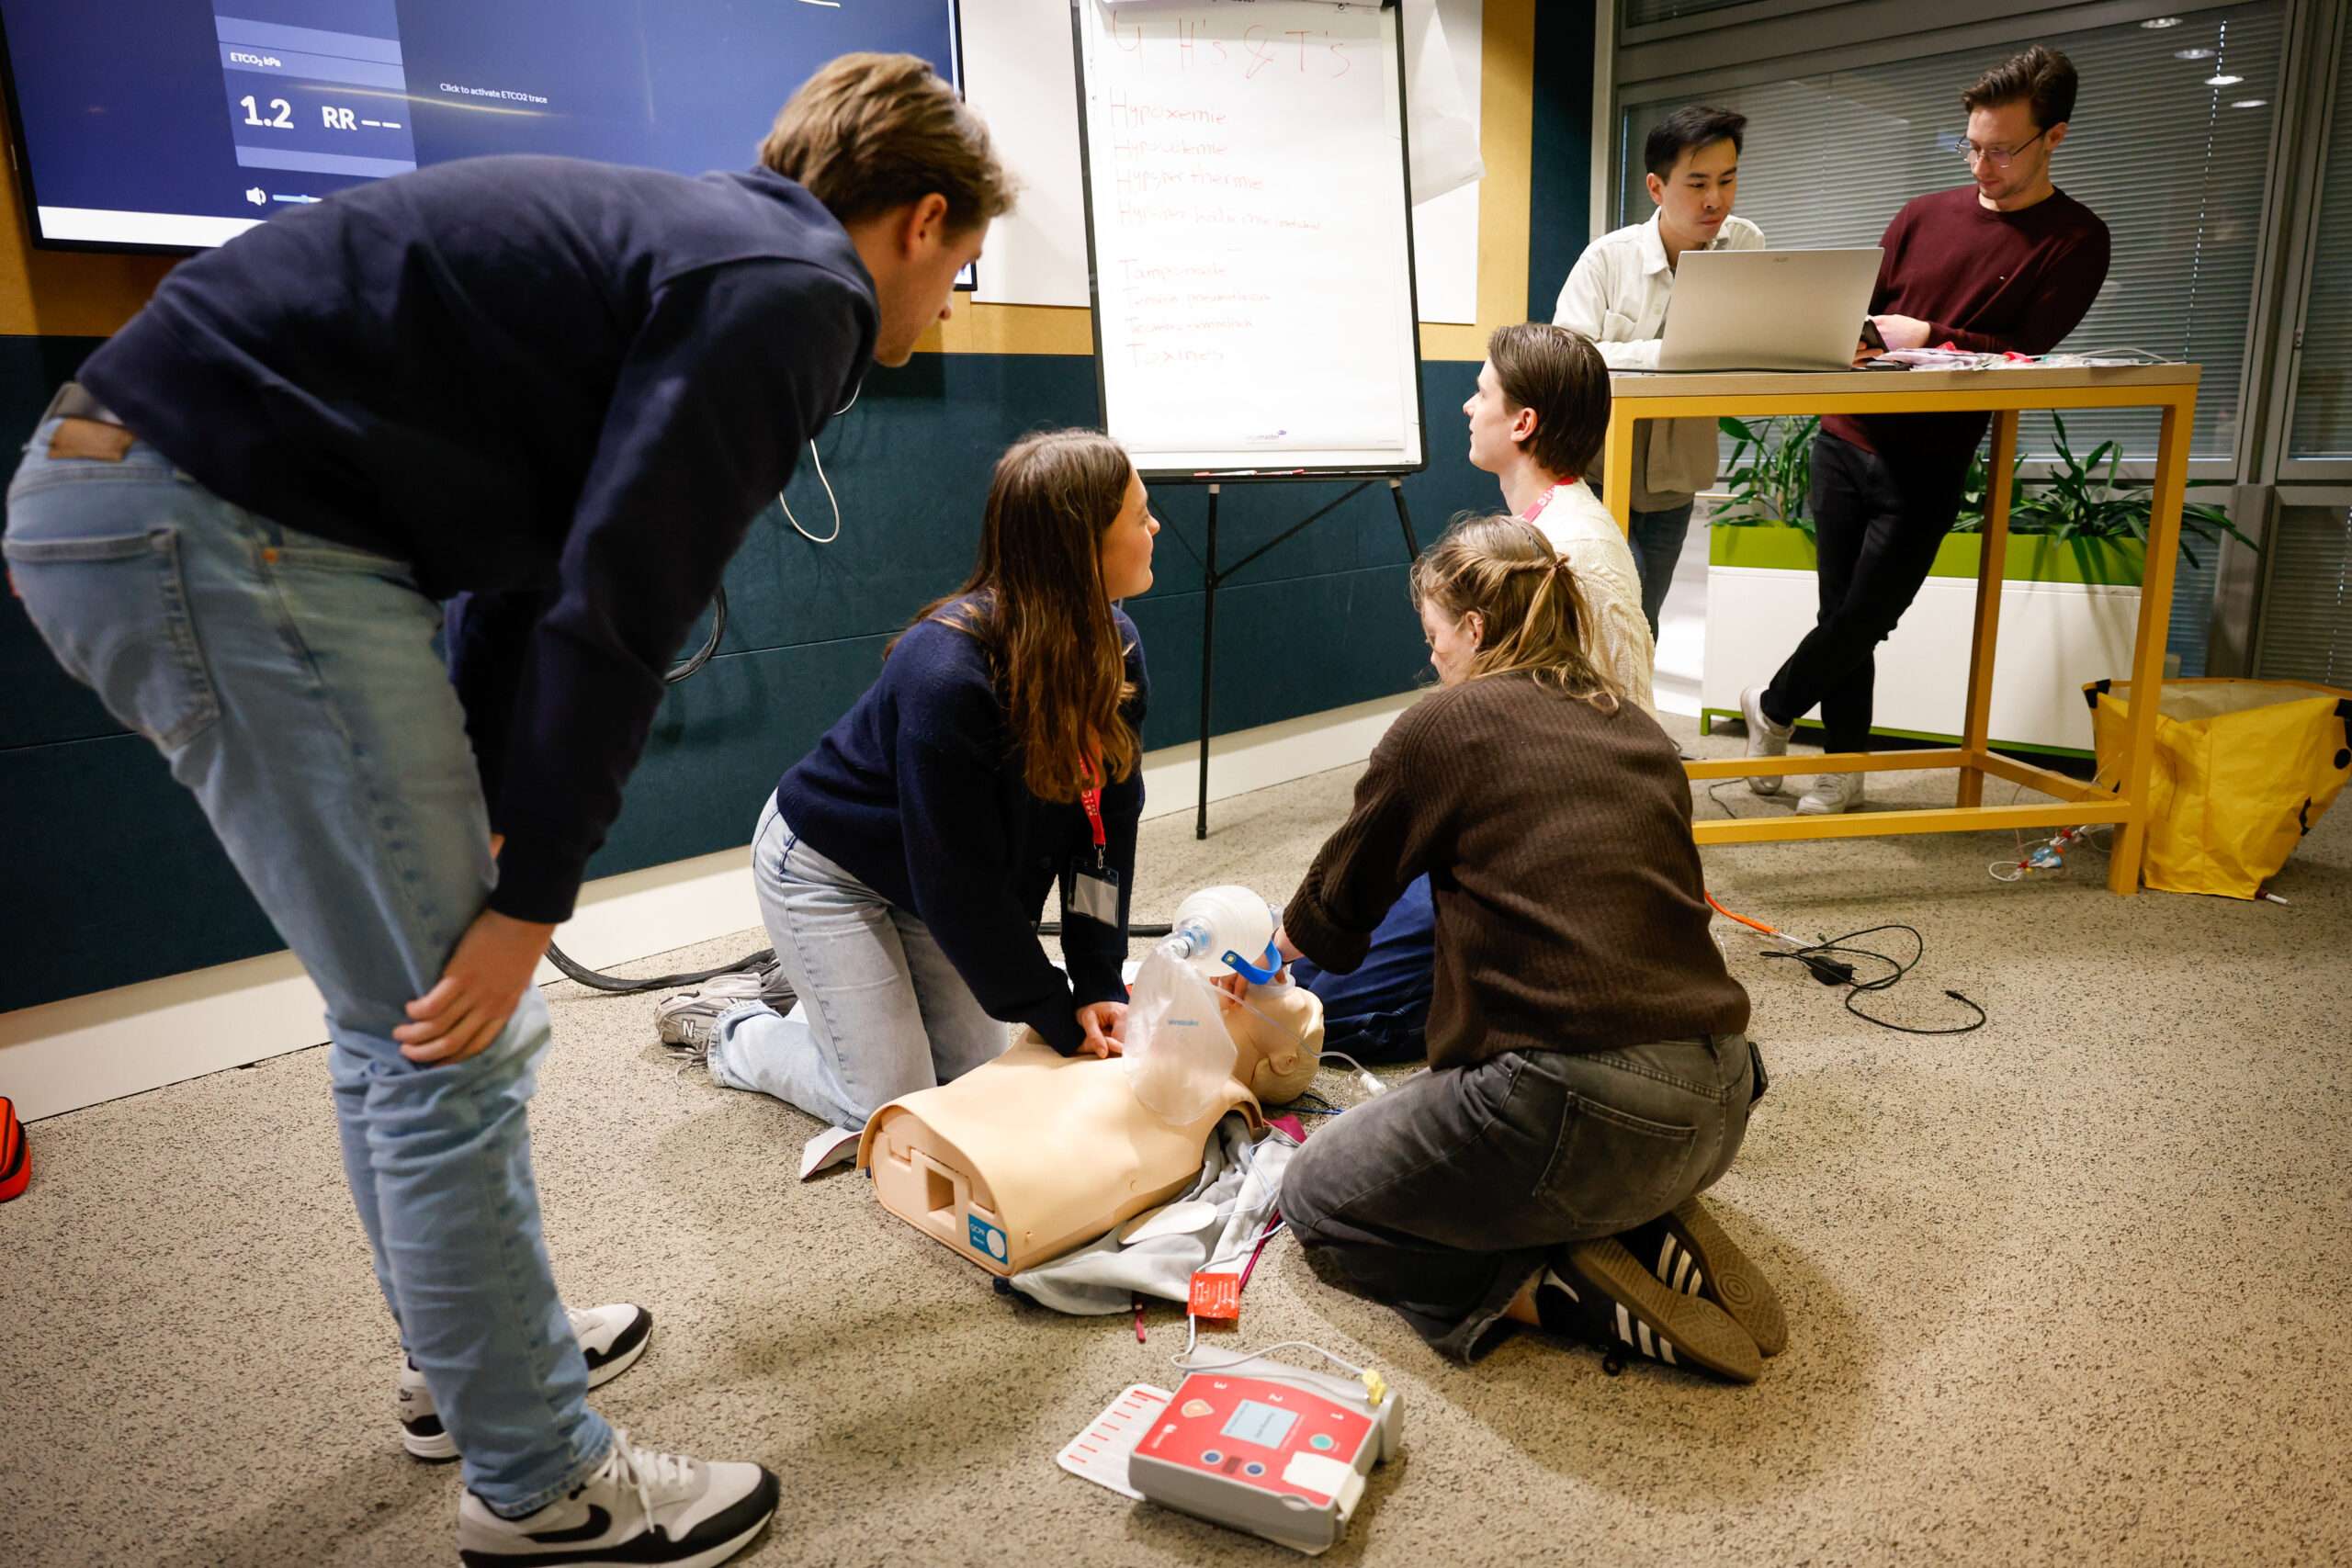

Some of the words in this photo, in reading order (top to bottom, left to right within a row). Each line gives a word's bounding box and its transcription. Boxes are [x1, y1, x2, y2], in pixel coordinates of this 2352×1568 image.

[1179, 16, 1227, 72] H's
[1285, 30, 1351, 78] T's
[440, 83, 459, 94] Click
[460, 85, 469, 95] to
[470, 88, 501, 98] activate
[501, 90, 527, 101] ETCO2
[528, 96, 548, 104] trace
[241, 95, 294, 130] 1.2
[322, 106, 357, 130] RR
